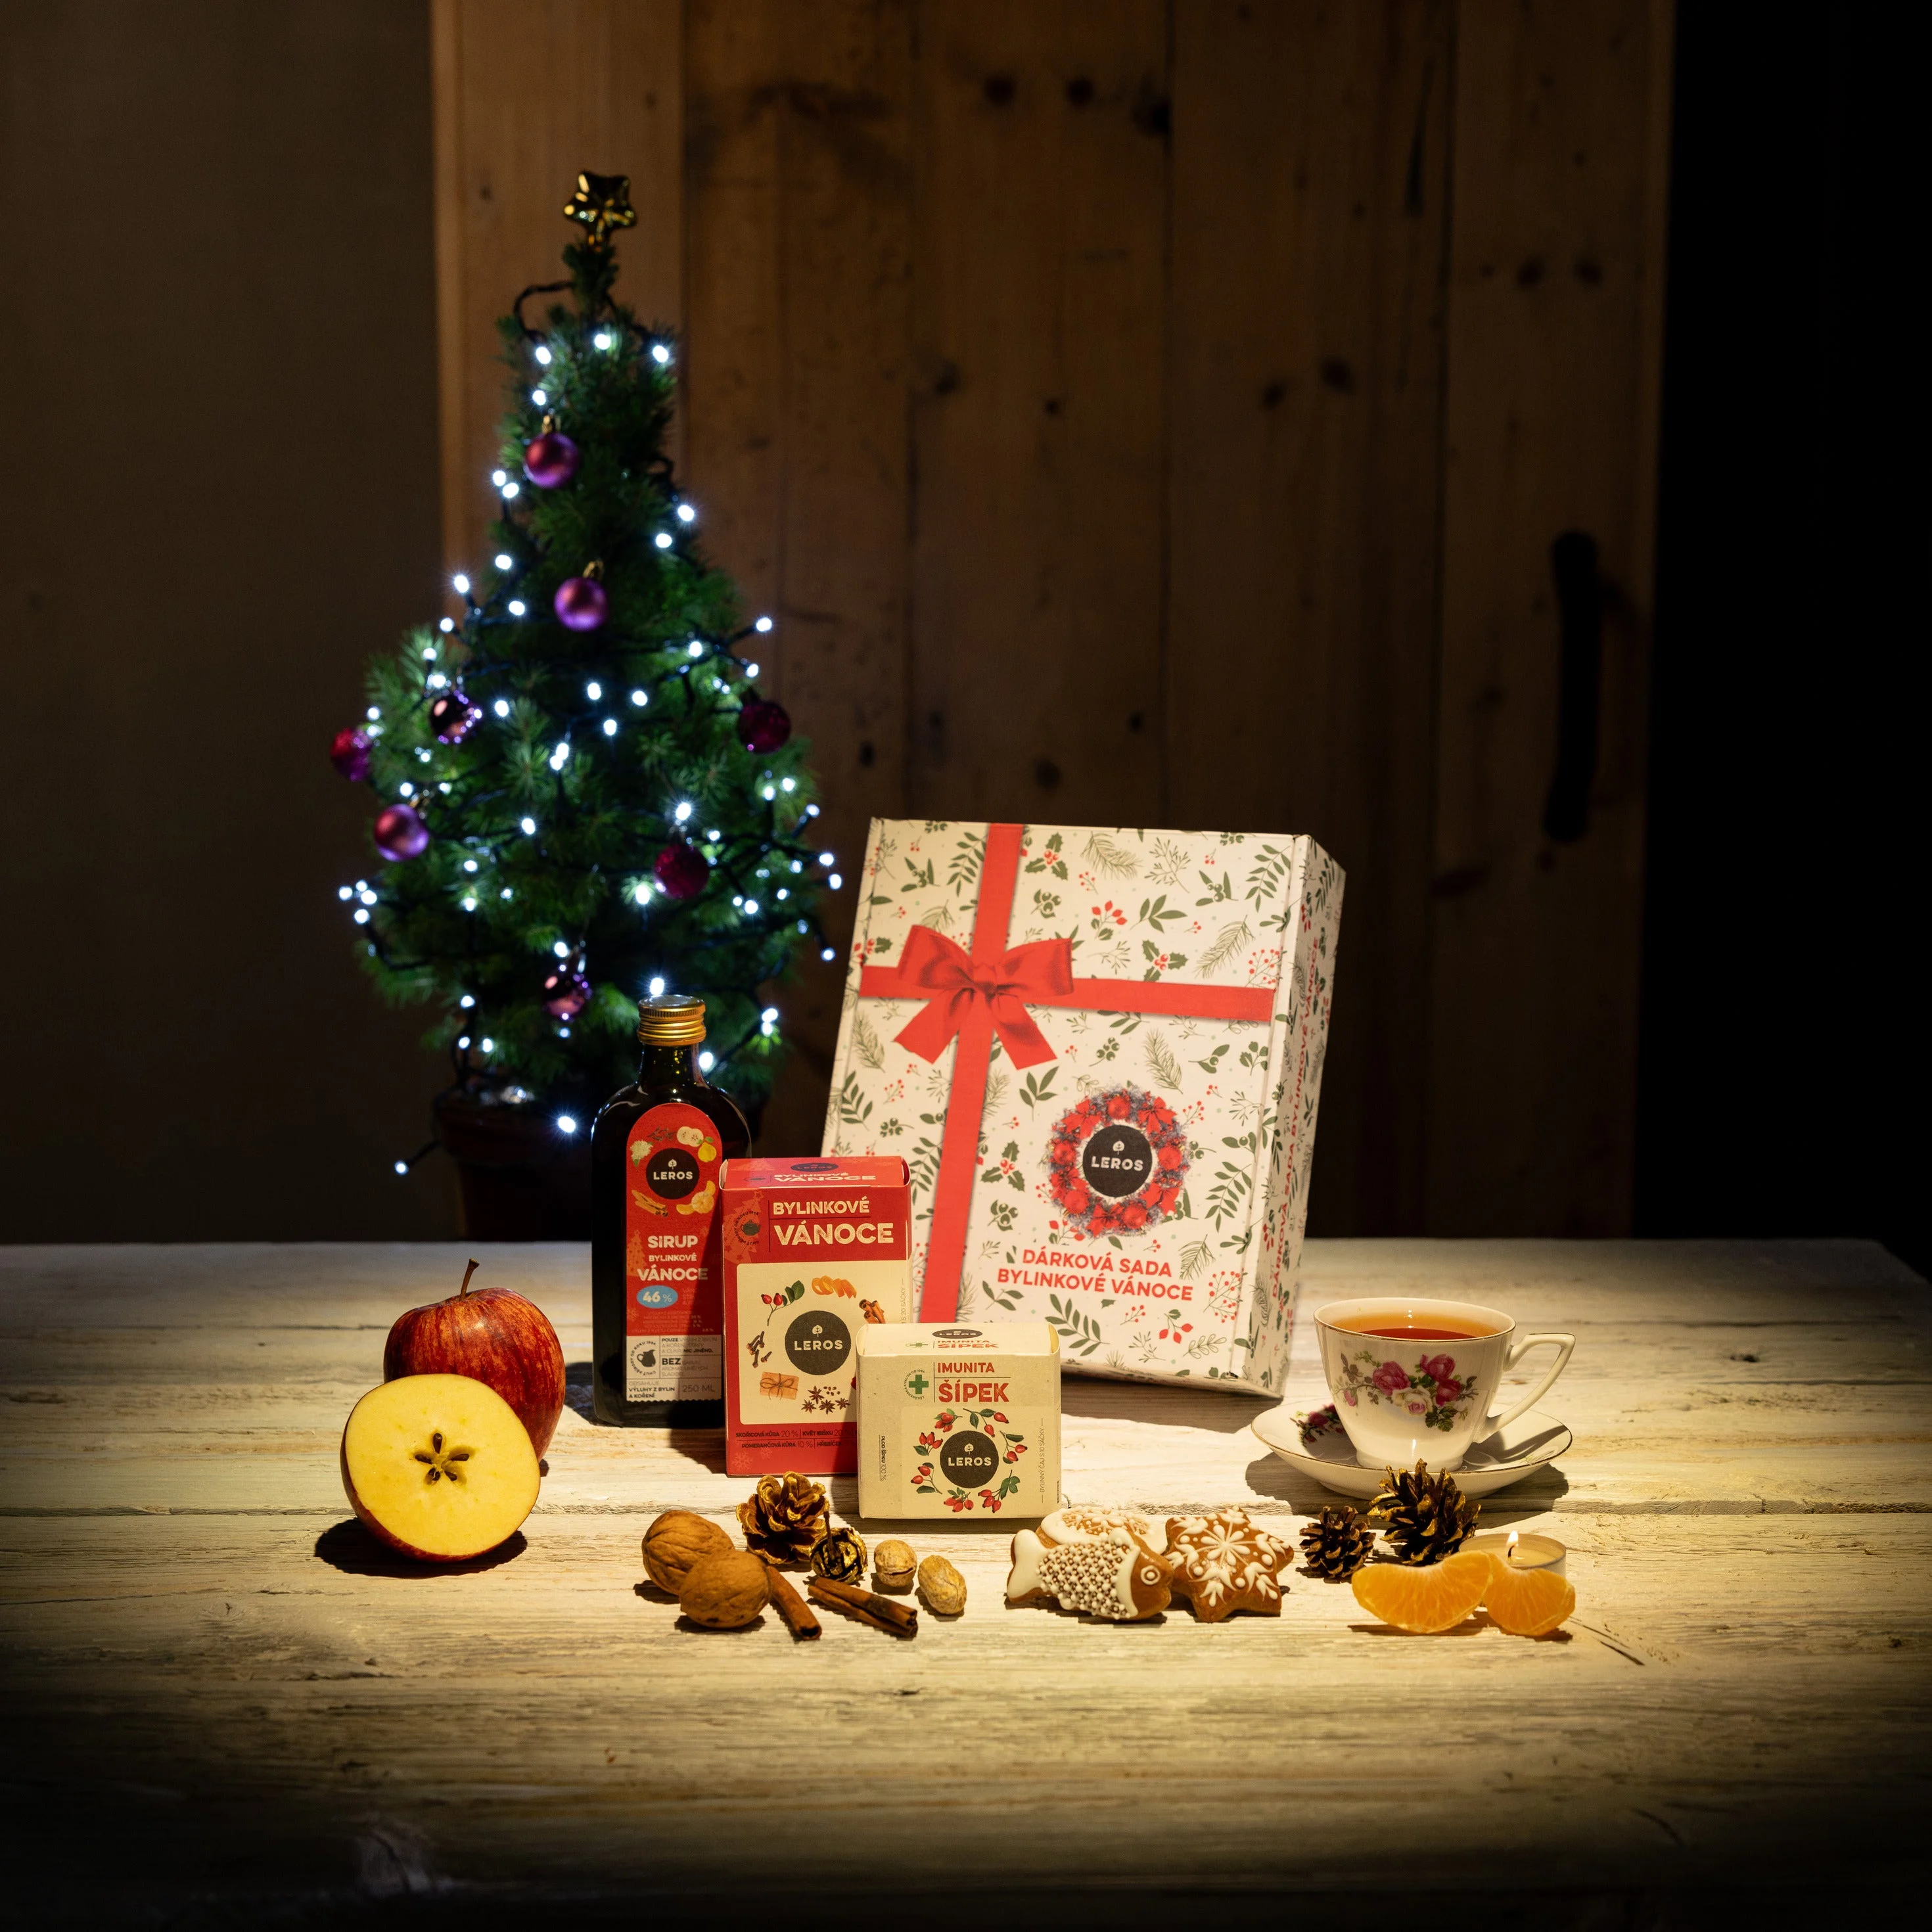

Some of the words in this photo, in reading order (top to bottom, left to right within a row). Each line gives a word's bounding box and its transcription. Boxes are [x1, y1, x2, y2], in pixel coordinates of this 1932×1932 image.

[1272, 1202, 1287, 1299] DÁRKOVÁ
[1284, 1142, 1295, 1197] SADA
[1291, 1024, 1308, 1136] BYLINKOVÉ
[1304, 936, 1319, 1018] VÁNOCE
[1091, 1155, 1143, 1172] LEROS
[653, 1171, 693, 1180] LEROS
[773, 1195, 870, 1215] BYLINKOVÉ
[773, 1220, 894, 1246] VÁNOCE
[647, 1235, 699, 1249] SIRUP
[648, 1252, 697, 1262] BYLINKOVÉ
[1023, 1245, 1115, 1272] DÁRKOVÁ
[1119, 1258, 1172, 1277] SADA
[637, 1264, 708, 1281] VÁNOCE
[997, 1268, 1105, 1293] BYLINKOVÉ
[1111, 1275, 1194, 1301] VÁNOCE
[642, 1291, 661, 1302] 46
[662, 1293, 672, 1302] %
[794, 1339, 843, 1352] LEROS
[937, 1362, 995, 1373] IMUNITA
[938, 1379, 1010, 1403] ŠÍPEK
[948, 1457, 992, 1466] LEROS
